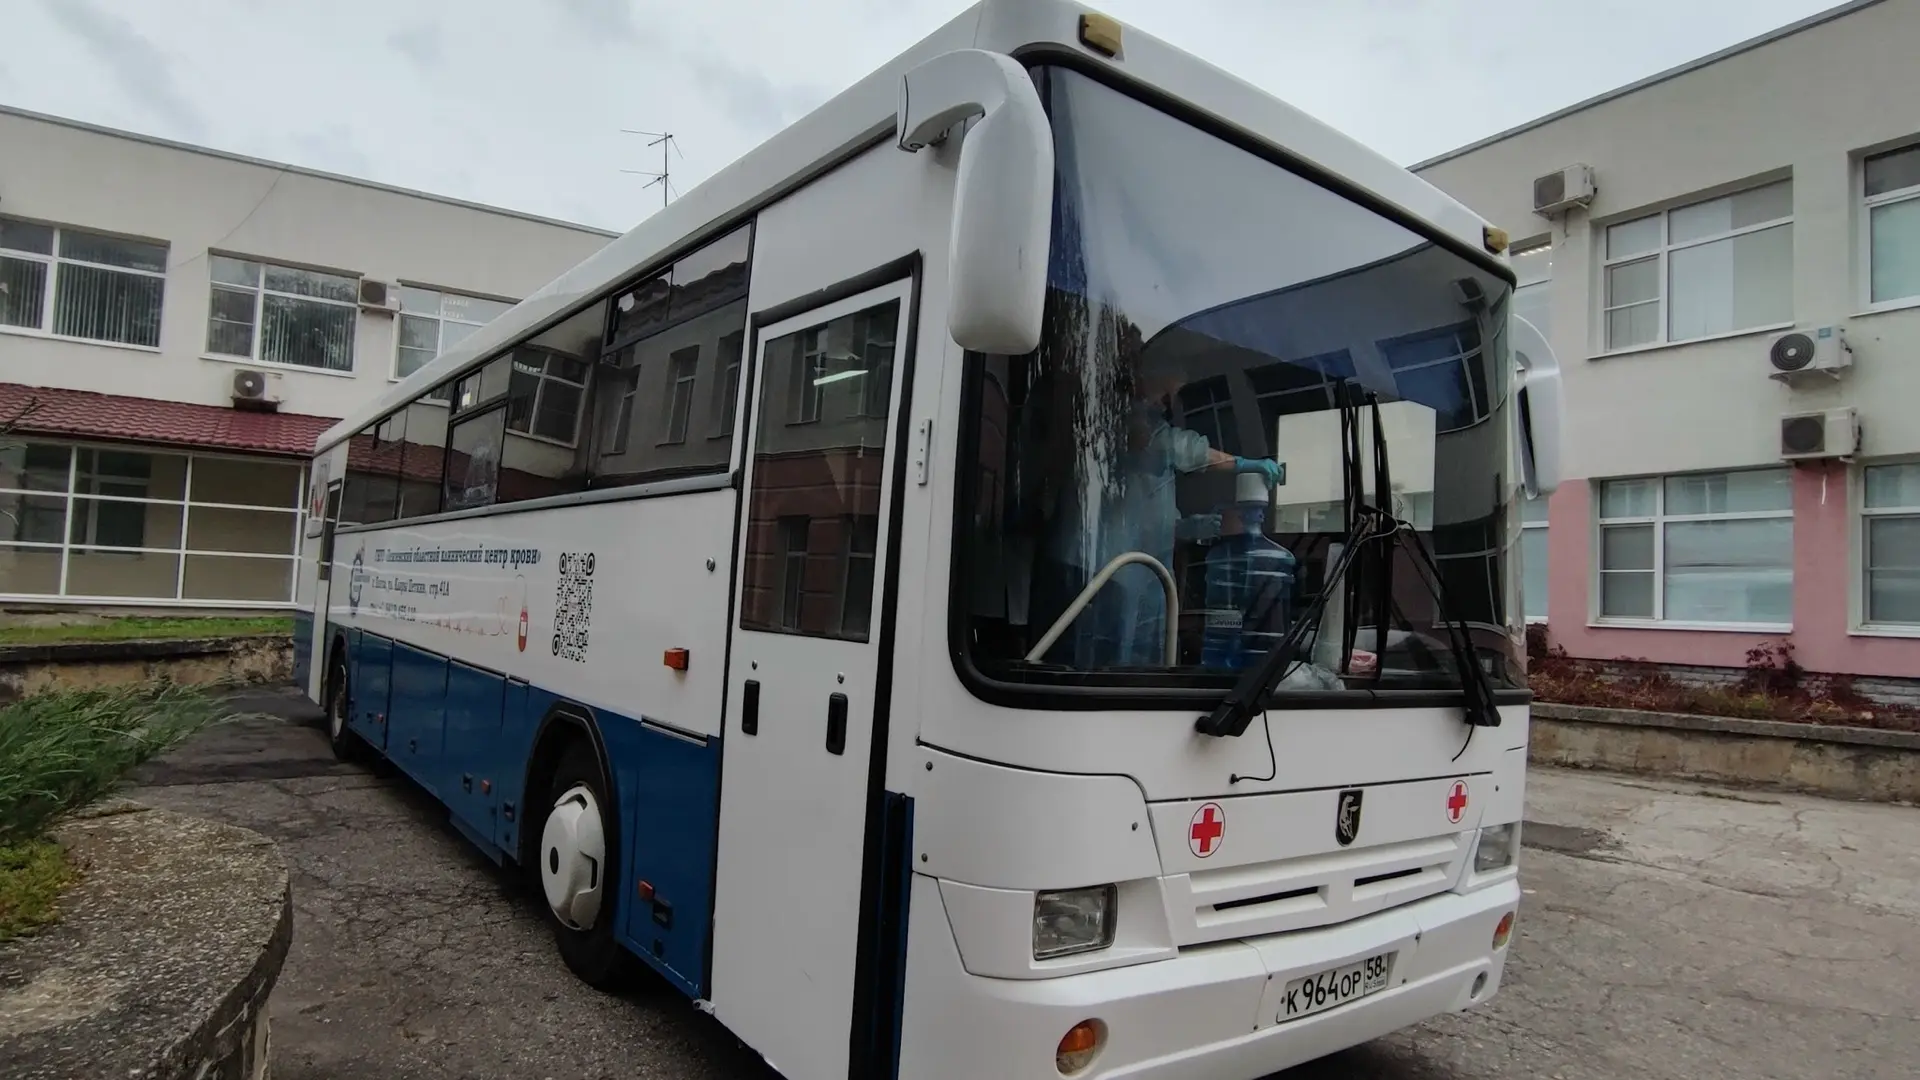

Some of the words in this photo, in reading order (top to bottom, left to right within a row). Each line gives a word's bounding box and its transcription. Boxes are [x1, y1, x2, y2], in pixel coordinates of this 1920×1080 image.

[440, 543, 483, 562] клинический
[484, 549, 508, 569] центр
[1366, 955, 1382, 980] 58
